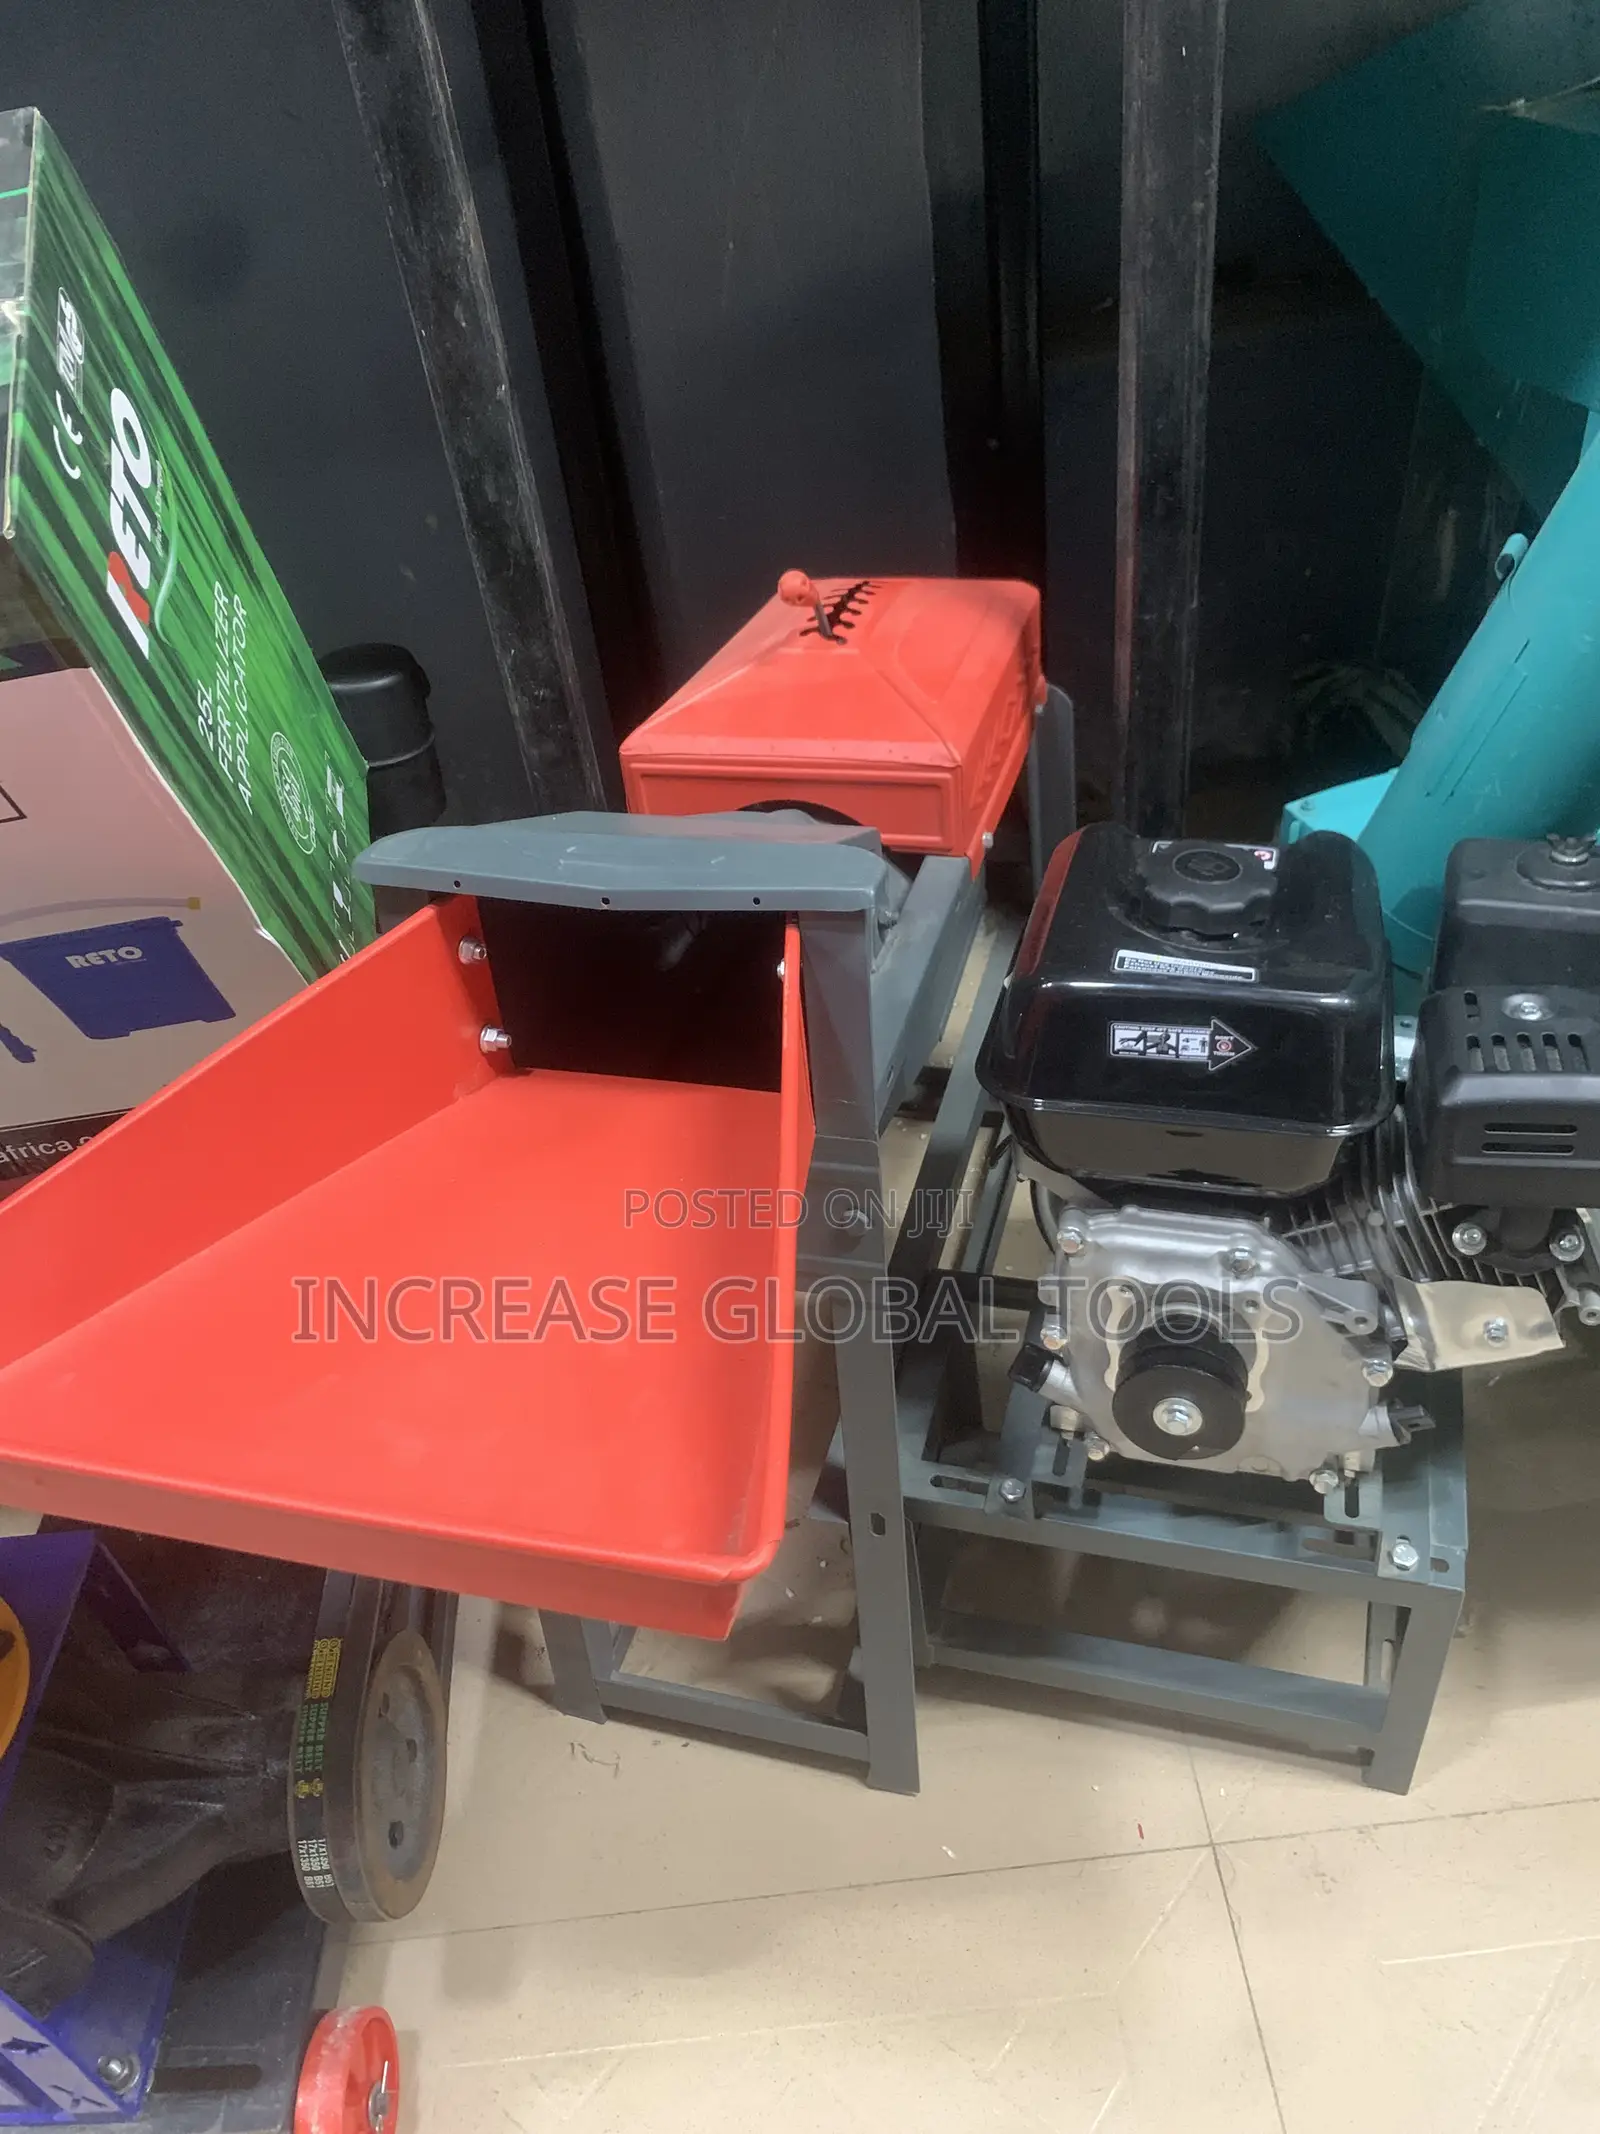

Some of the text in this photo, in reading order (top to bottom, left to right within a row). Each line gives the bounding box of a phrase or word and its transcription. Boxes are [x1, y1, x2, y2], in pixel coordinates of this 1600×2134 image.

[107, 387, 152, 661] RETO
[197, 679, 214, 752] 25L
[214, 580, 234, 783] FERTILIZER
[231, 594, 252, 815] APPLICATOR
[65, 946, 143, 969] RETO
[297, 1840, 311, 1871] 17x1350
[307, 1839, 324, 1888] 17x1350 B51
